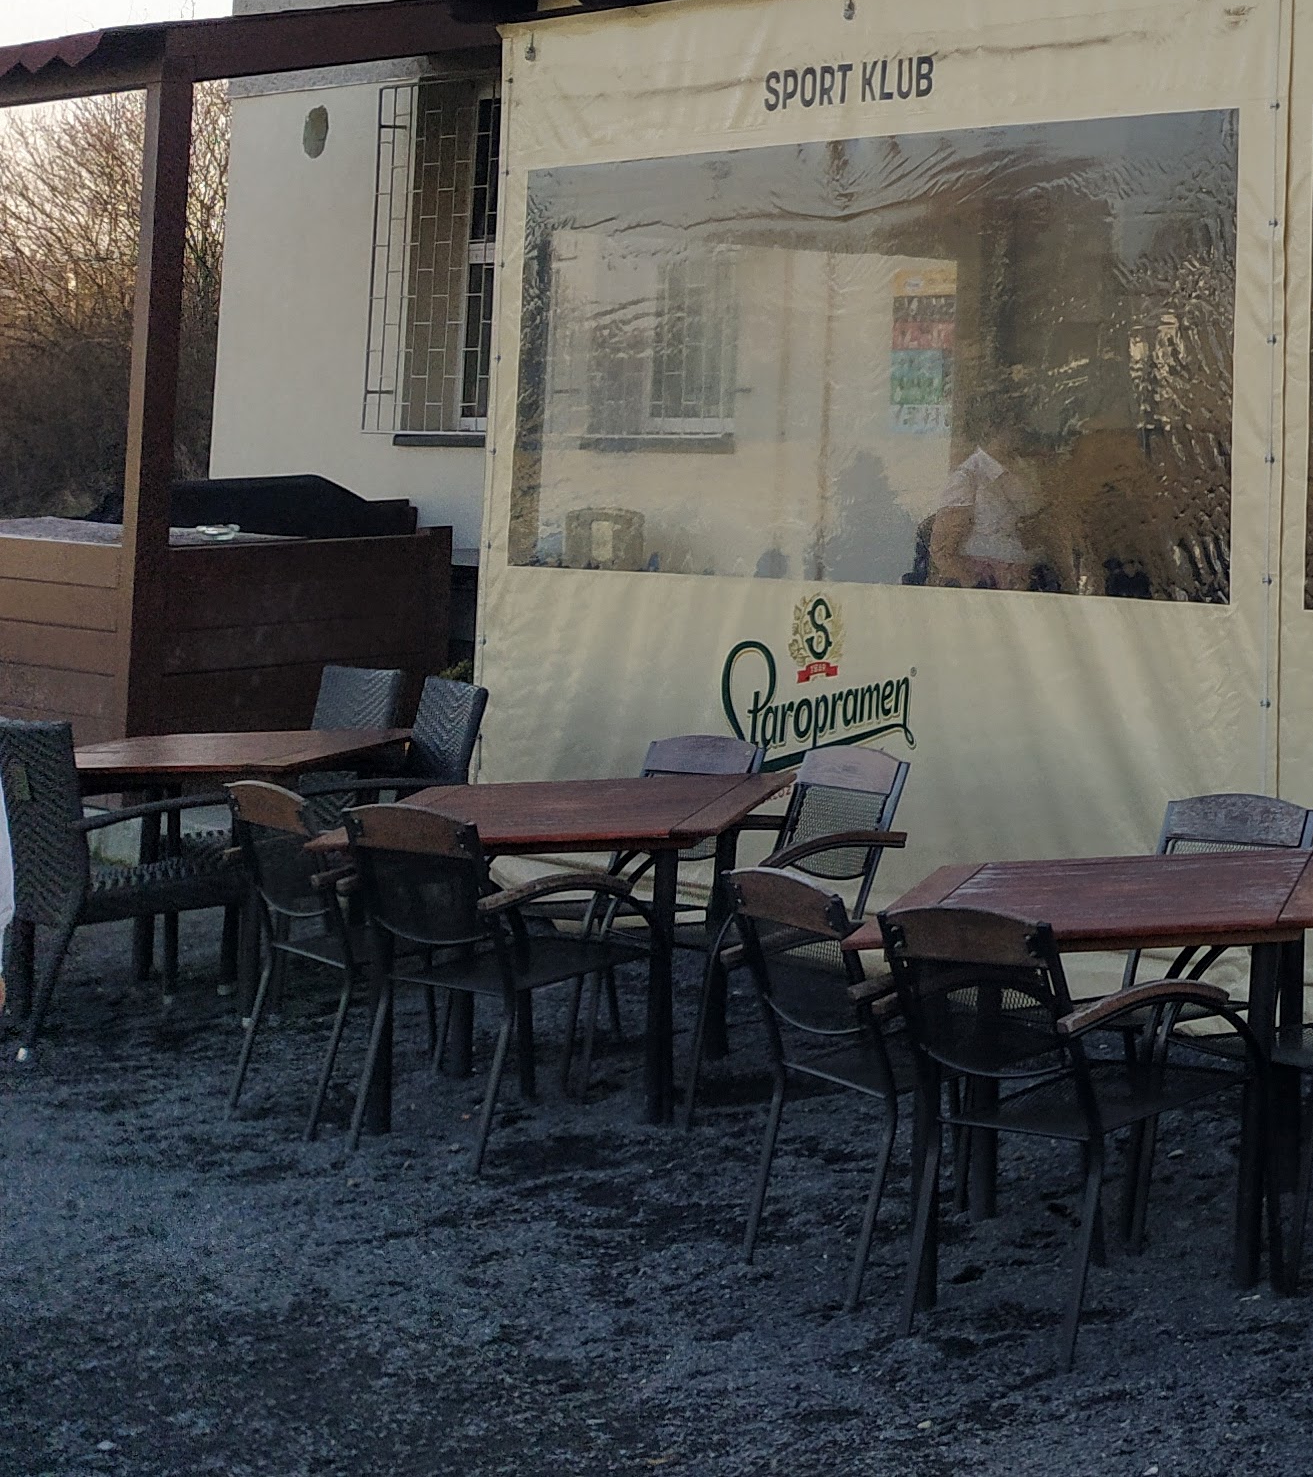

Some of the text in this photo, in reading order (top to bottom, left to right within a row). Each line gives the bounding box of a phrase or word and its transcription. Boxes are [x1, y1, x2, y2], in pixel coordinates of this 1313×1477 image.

[764, 55, 935, 111] SPORT KLUB
[721, 640, 918, 753] Staropramen
